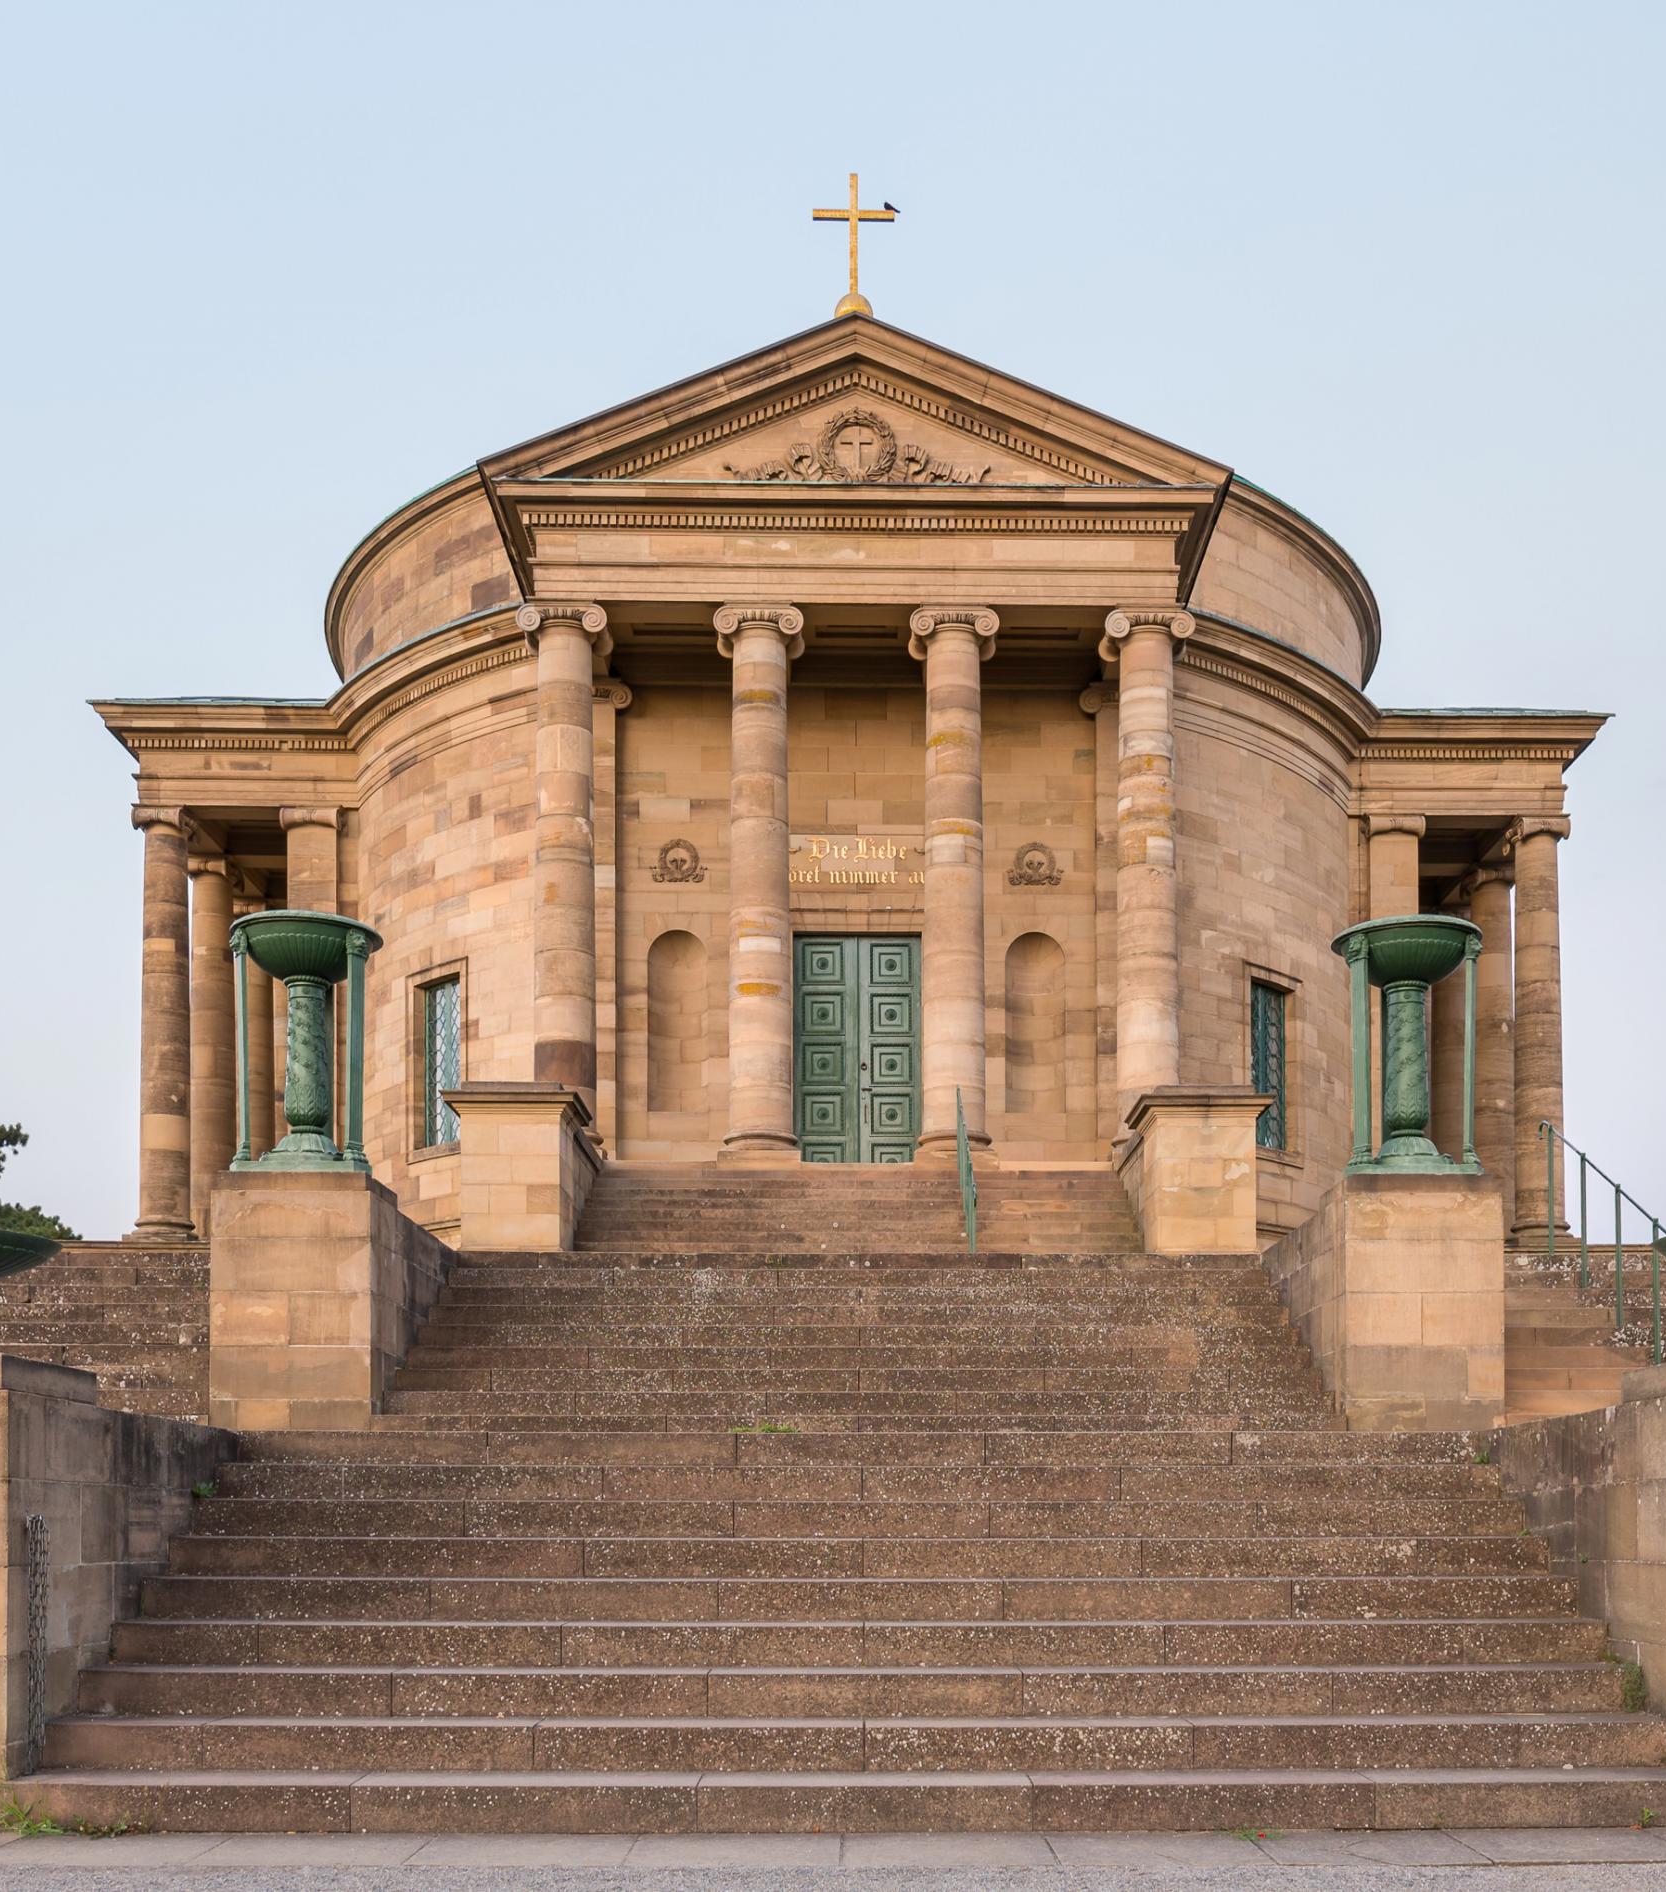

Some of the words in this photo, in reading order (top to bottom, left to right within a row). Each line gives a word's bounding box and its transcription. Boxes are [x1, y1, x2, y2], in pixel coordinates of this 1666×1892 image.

[806, 837, 848, 862] Die
[854, 838, 907, 862] Liebe
[789, 864, 820, 883] öret
[829, 865, 898, 884] nimmer
